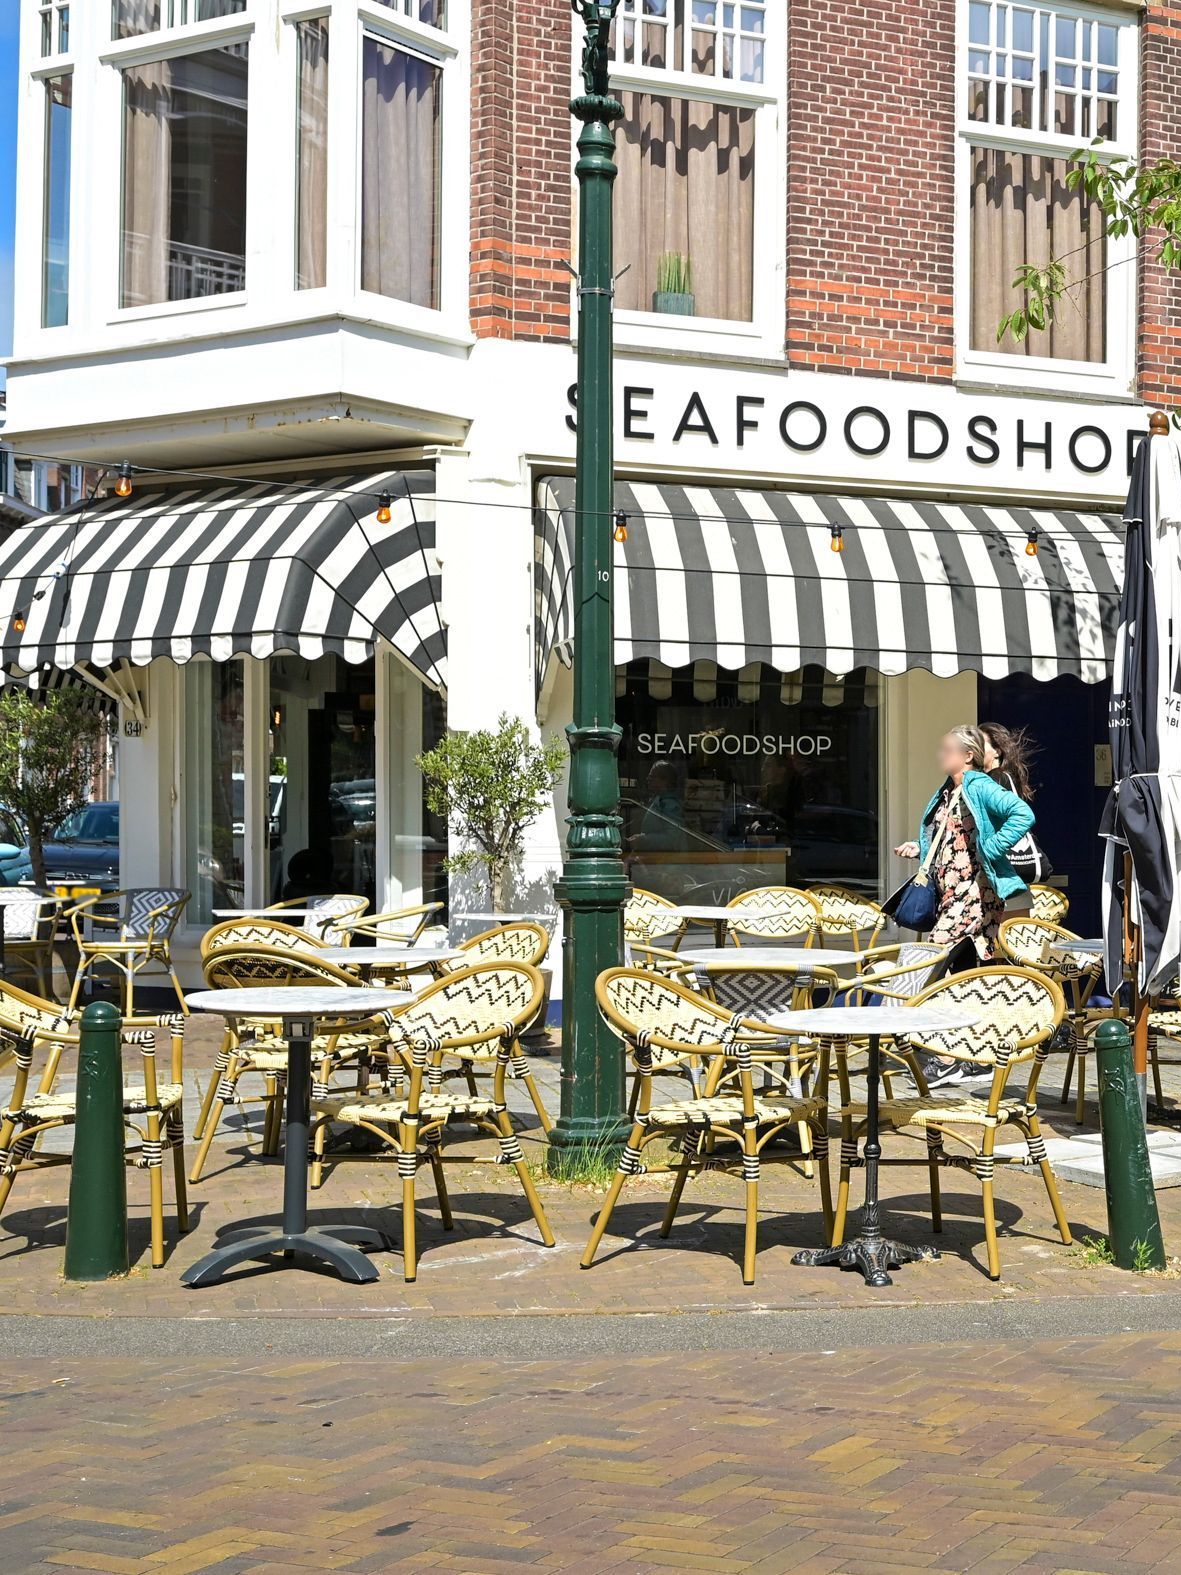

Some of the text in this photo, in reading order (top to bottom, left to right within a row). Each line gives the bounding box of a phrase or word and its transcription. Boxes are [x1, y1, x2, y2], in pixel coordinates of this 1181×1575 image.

[597, 570, 609, 581] 10
[127, 721, 140, 737] 34
[637, 733, 832, 755] SEAFOODSHOP
